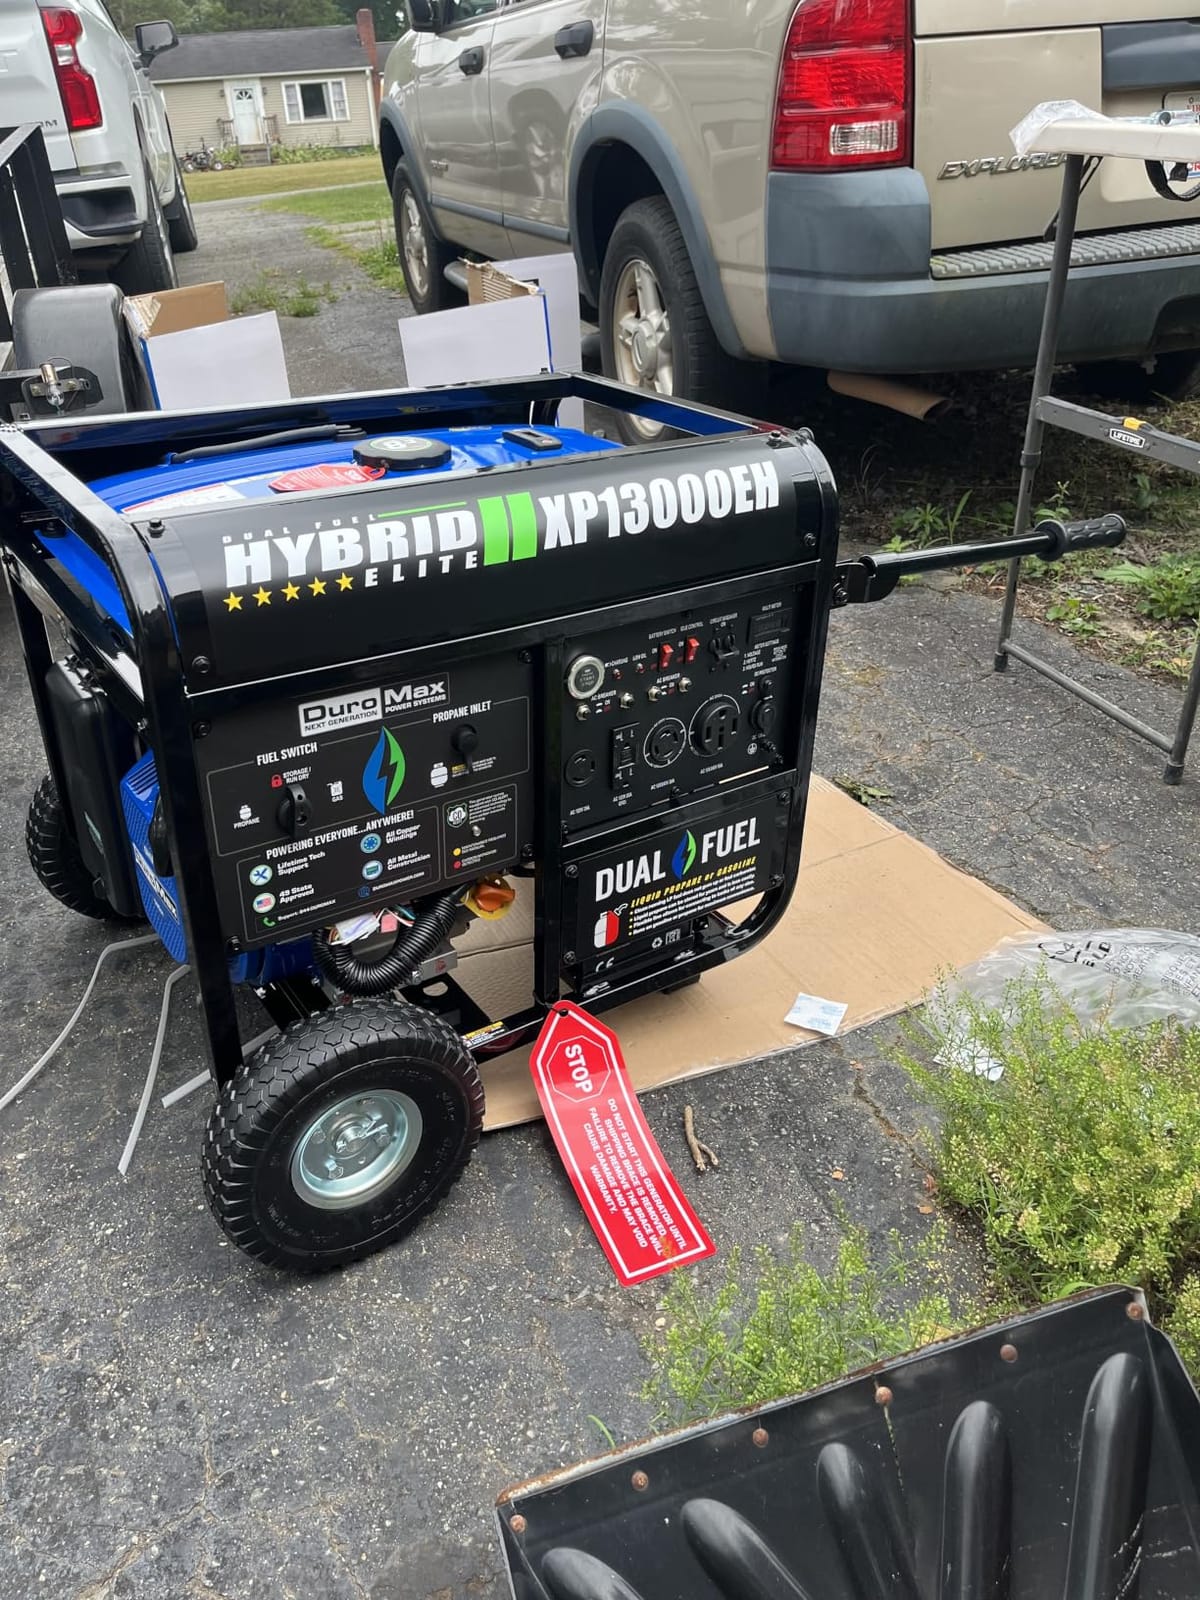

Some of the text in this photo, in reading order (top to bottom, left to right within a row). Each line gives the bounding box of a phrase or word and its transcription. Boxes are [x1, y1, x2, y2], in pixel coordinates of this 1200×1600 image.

[539, 460, 779, 550] XP13000EH
[222, 513, 378, 544] DUAL FUEL
[224, 509, 478, 588] HYBRID
[364, 550, 478, 588] ELITE
[384, 681, 446, 705] Max
[384, 694, 446, 714] POWER SYSTEMS
[303, 697, 377, 724] Duro
[304, 708, 378, 732] NEXT GENERATION
[432, 700, 492, 724] PROPANE INLET
[256, 742, 318, 766] FUEL SWITCH
[283, 768, 308, 779] STORAGE
[286, 773, 309, 784] RUN DRY
[332, 794, 343, 802] GAS
[234, 817, 260, 829] PROPANE
[386, 824, 421, 838] All Copper
[266, 838, 313, 860] POWERING
[386, 831, 418, 844] Windings
[277, 851, 326, 869] Lifetime Tech
[278, 863, 309, 876] Support
[388, 851, 418, 865] All Metal
[388, 853, 431, 871] Construction
[596, 817, 760, 902] DUAL FUEL
[280, 884, 312, 897] 49 State
[631, 856, 756, 908] LIQUID PROPANE or GASOLINE
[280, 888, 314, 903] Approved
[564, 1044, 593, 1094] STOP
[604, 1119, 627, 1159] SHIPPING
[622, 1158, 641, 1187] BRACE
[636, 1186, 646, 1196] IS
[584, 1122, 648, 1248] CAUSE DAMAGE AND MAY VOID
[589, 1107, 664, 1256] FAILURE TO REMOVE THE BRACE WILL
[608, 1098, 687, 1249] DO NOT START THIS GENERATOR UNTIL
[590, 1164, 618, 1214] WARRANTY.
